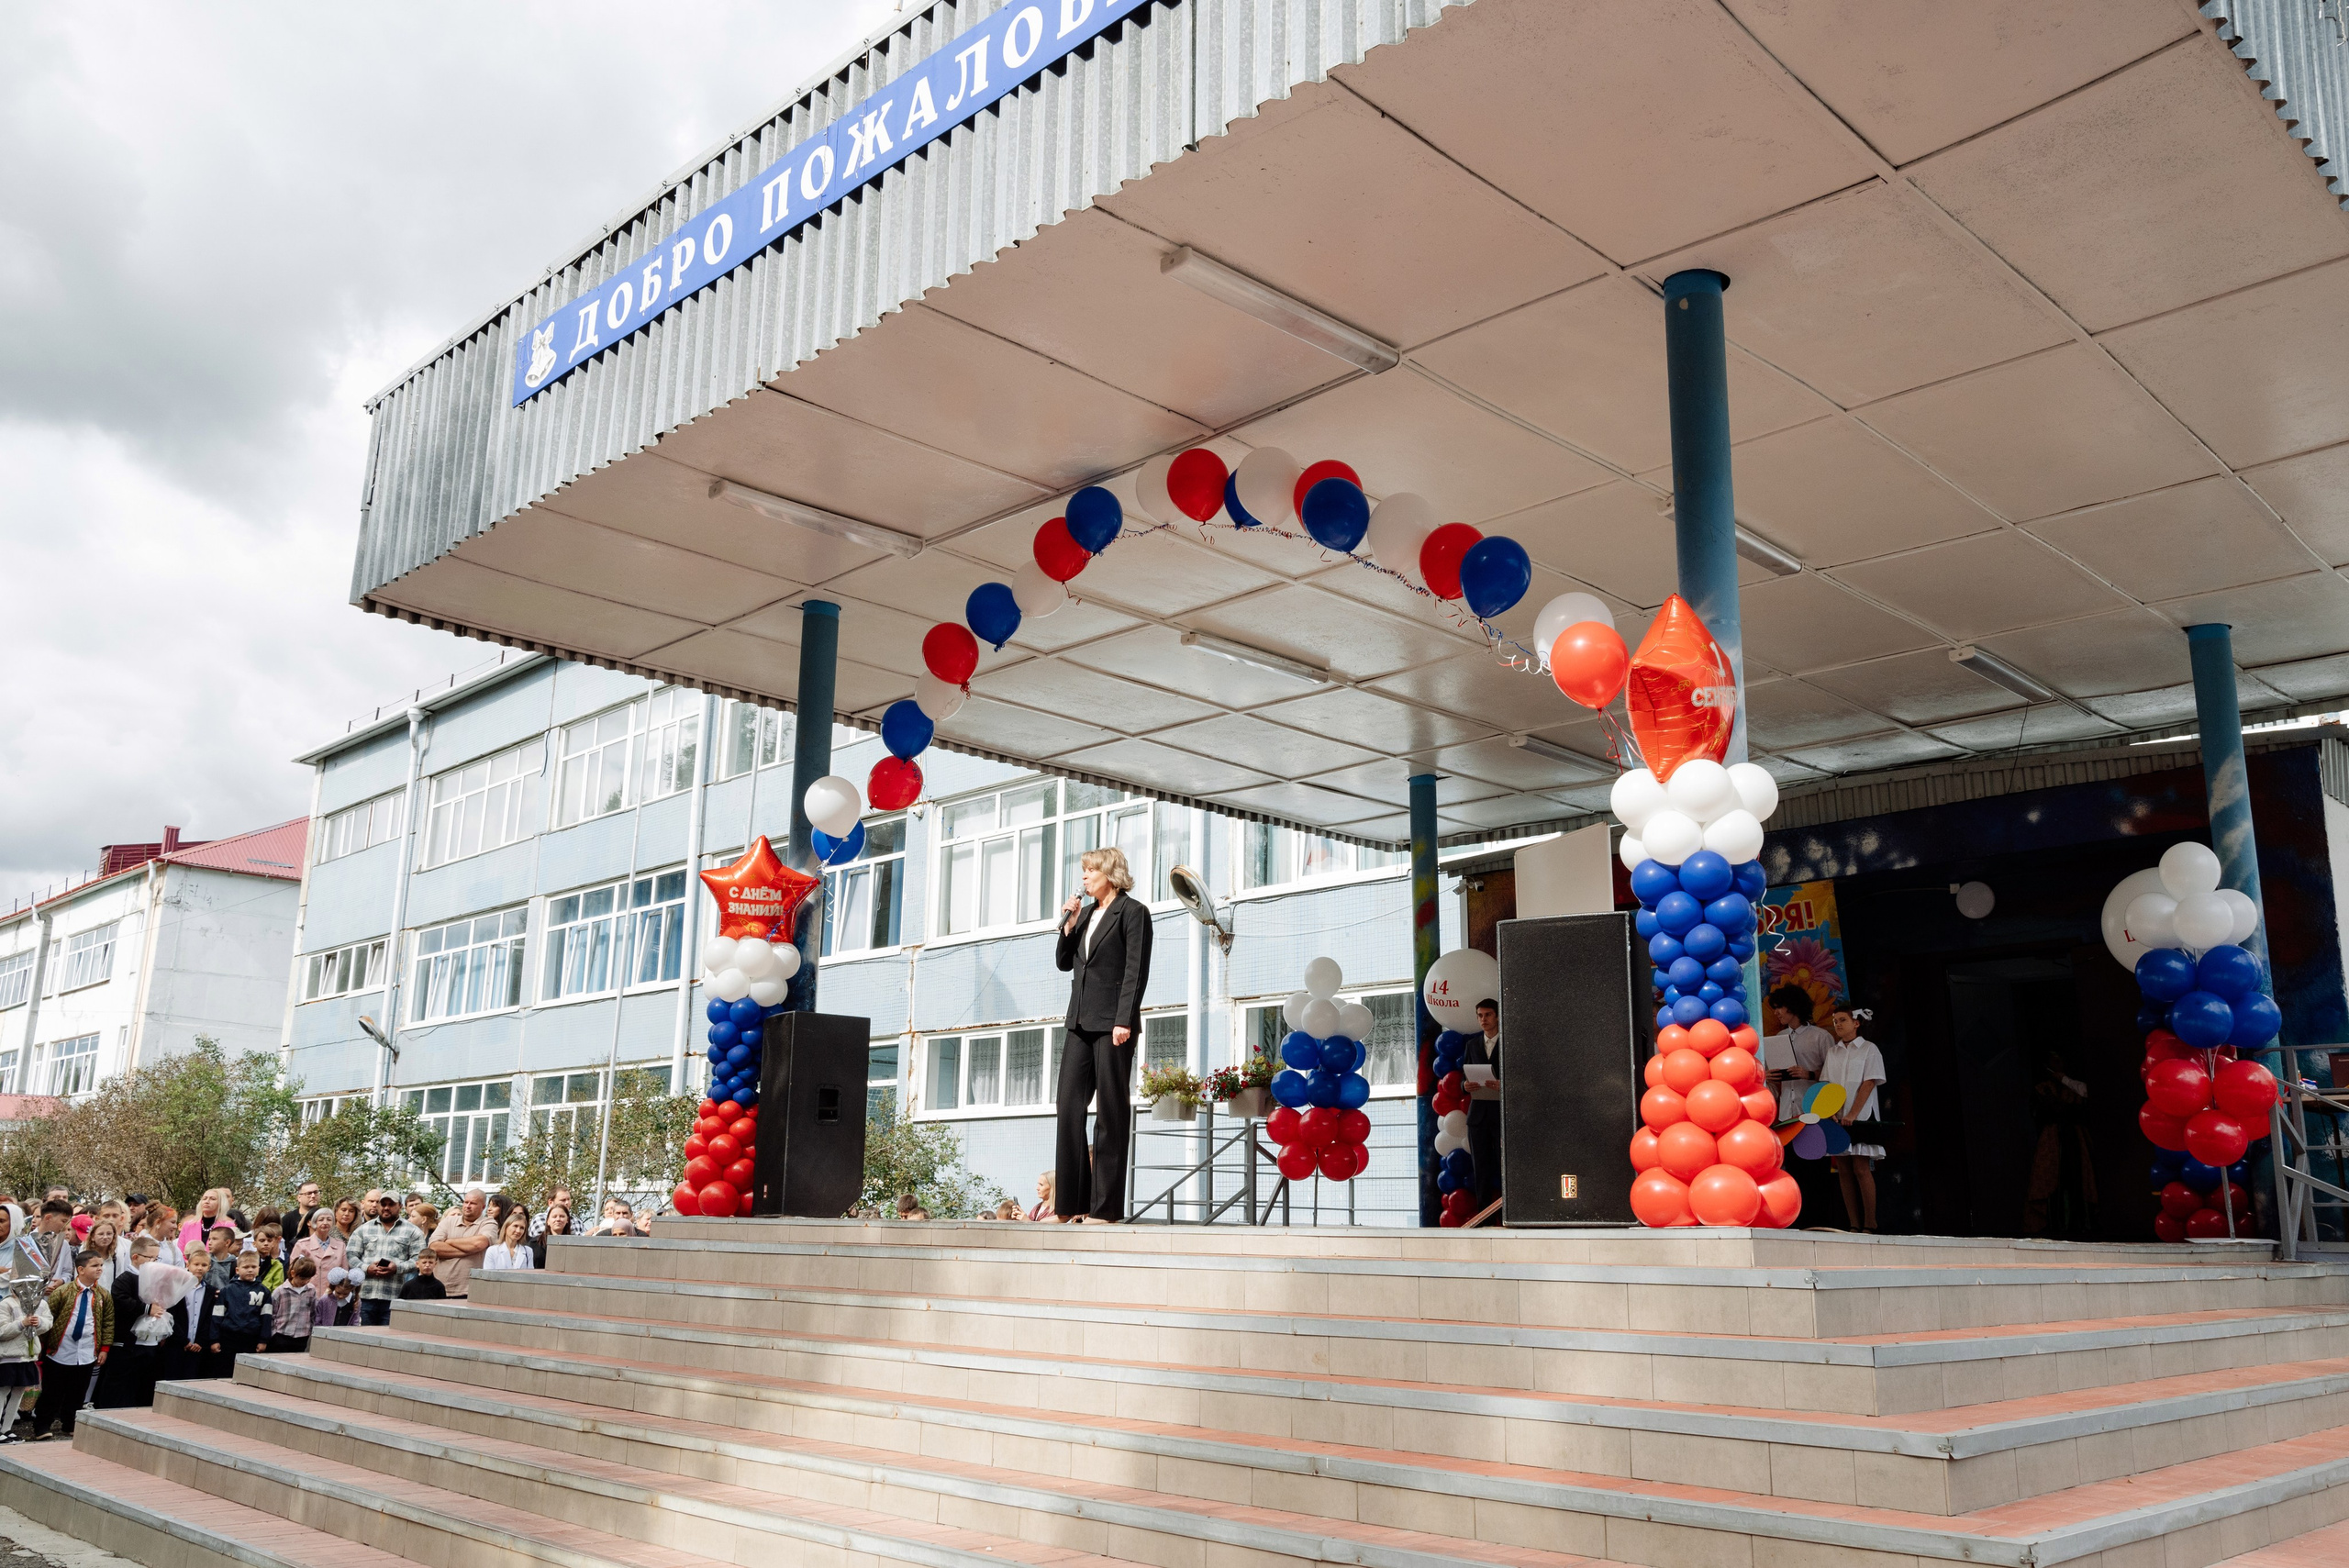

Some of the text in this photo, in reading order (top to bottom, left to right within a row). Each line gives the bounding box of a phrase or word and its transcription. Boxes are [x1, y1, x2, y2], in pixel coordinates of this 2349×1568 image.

[569, 0, 1118, 363] ДОБРО ПОЖАЛОВ
[729, 885, 783, 902] С ДНЁМ
[728, 901, 785, 917] ЗНАНИЙ!
[1431, 979, 1450, 995] 14
[249, 1291, 264, 1306] M
